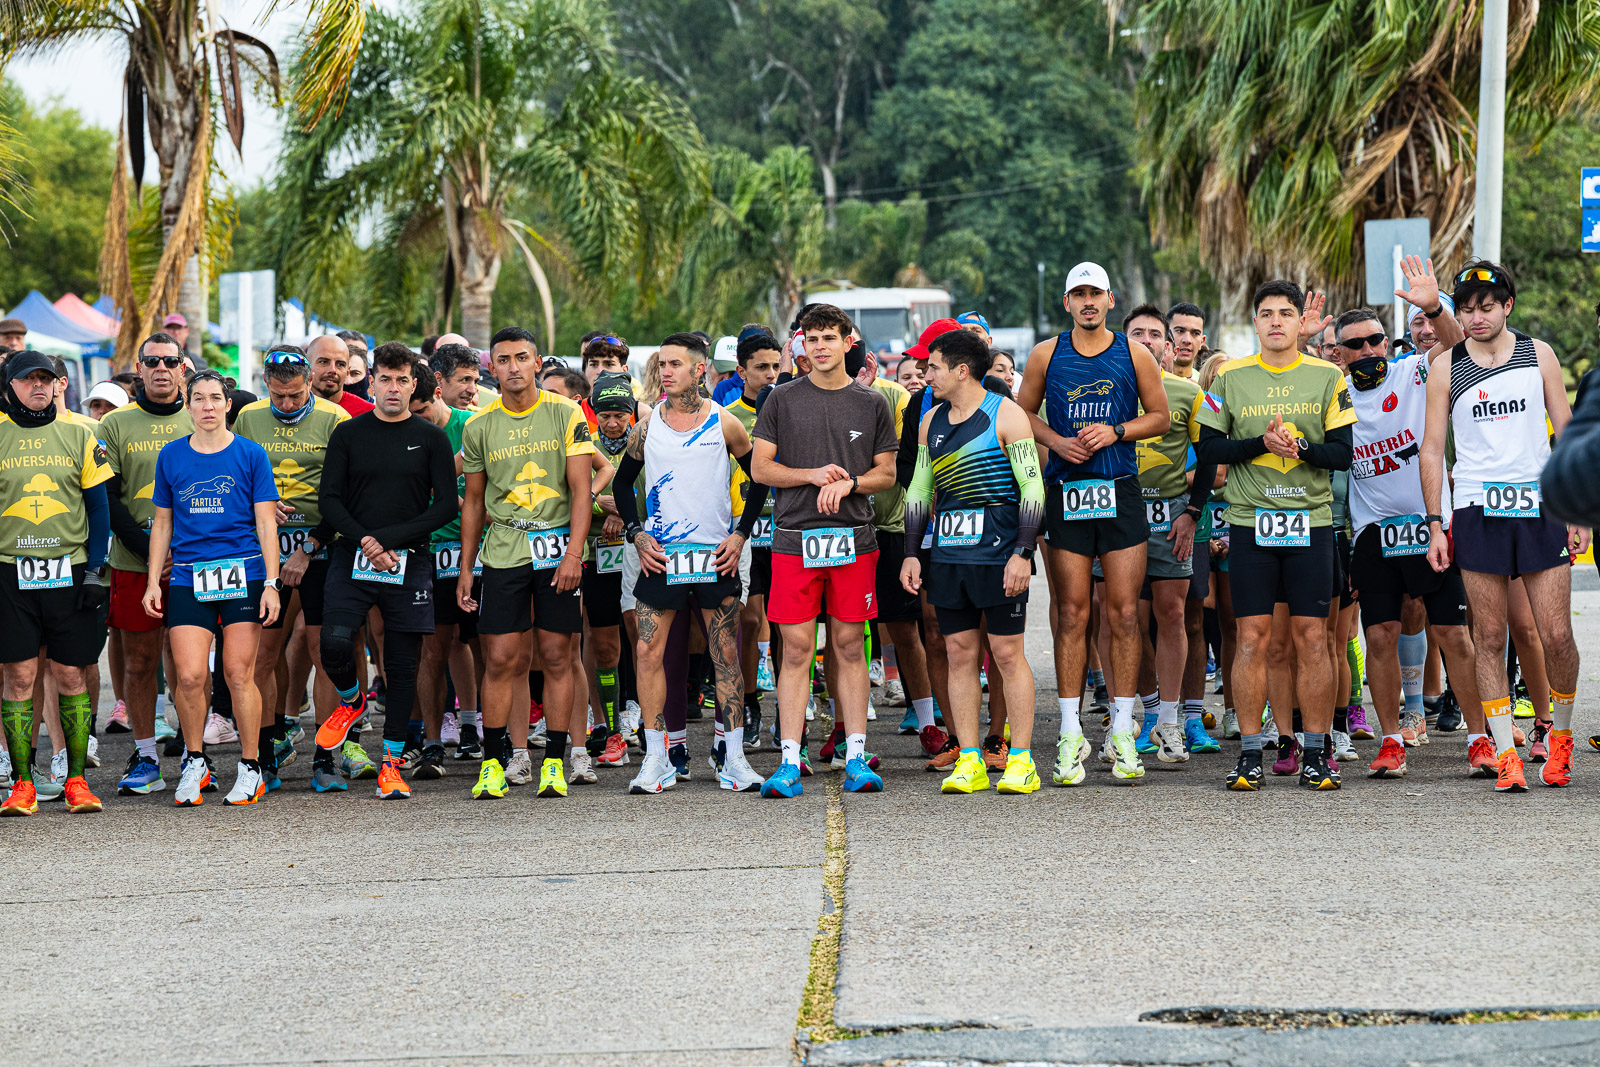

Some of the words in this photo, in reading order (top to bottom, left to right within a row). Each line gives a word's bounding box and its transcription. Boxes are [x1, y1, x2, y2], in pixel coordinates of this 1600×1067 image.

[1266, 385, 1295, 398] 216°
[1068, 402, 1112, 419] FARTLEK
[1240, 402, 1322, 418] ANIVERSARIO
[1472, 398, 1526, 418] ATENAS
[151, 424, 178, 435] 216°
[273, 426, 299, 437] 216°
[508, 425, 533, 440] 216°
[18, 437, 47, 450] 216°
[489, 439, 559, 463] ANIVERSARIO
[1352, 428, 1415, 461] NICERÍA
[0, 455, 74, 471] NIVERSARIO
[1351, 455, 1400, 480] ALIA
[1066, 484, 1112, 512] 048
[1264, 484, 1307, 497] julicroc
[1486, 485, 1534, 511] 095
[191, 497, 222, 507] FARTLEK
[652, 485, 663, 540] GENTINA
[941, 510, 977, 538] 021
[1258, 511, 1306, 538] 034
[16, 535, 61, 548] julicroc
[1384, 521, 1430, 548] 046
[806, 534, 851, 560] 074
[1385, 548, 1412, 556] DIAMANTE
[20, 556, 65, 581] 037
[670, 550, 712, 575] 117
[197, 565, 242, 593] 114
[197, 593, 225, 601] DIAMANTE
